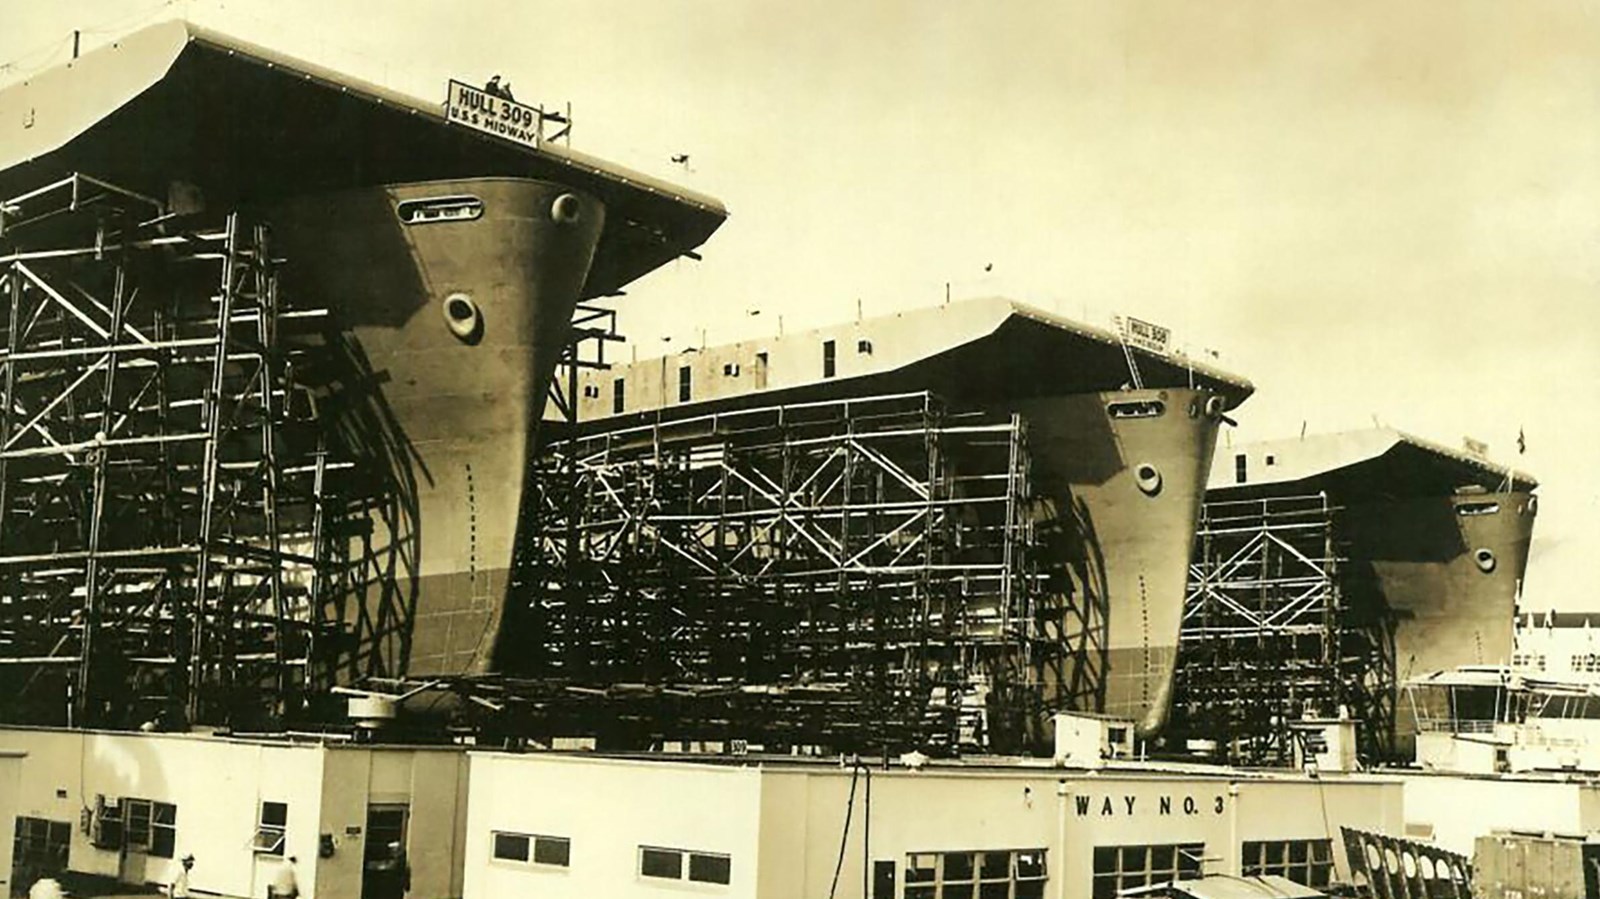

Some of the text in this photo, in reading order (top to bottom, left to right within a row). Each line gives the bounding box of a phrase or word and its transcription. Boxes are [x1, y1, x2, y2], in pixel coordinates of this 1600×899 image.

[459, 88, 532, 127] HULL 309
[484, 118, 534, 141] MIDWAY
[1075, 796, 1224, 815] WAY NO. 3
